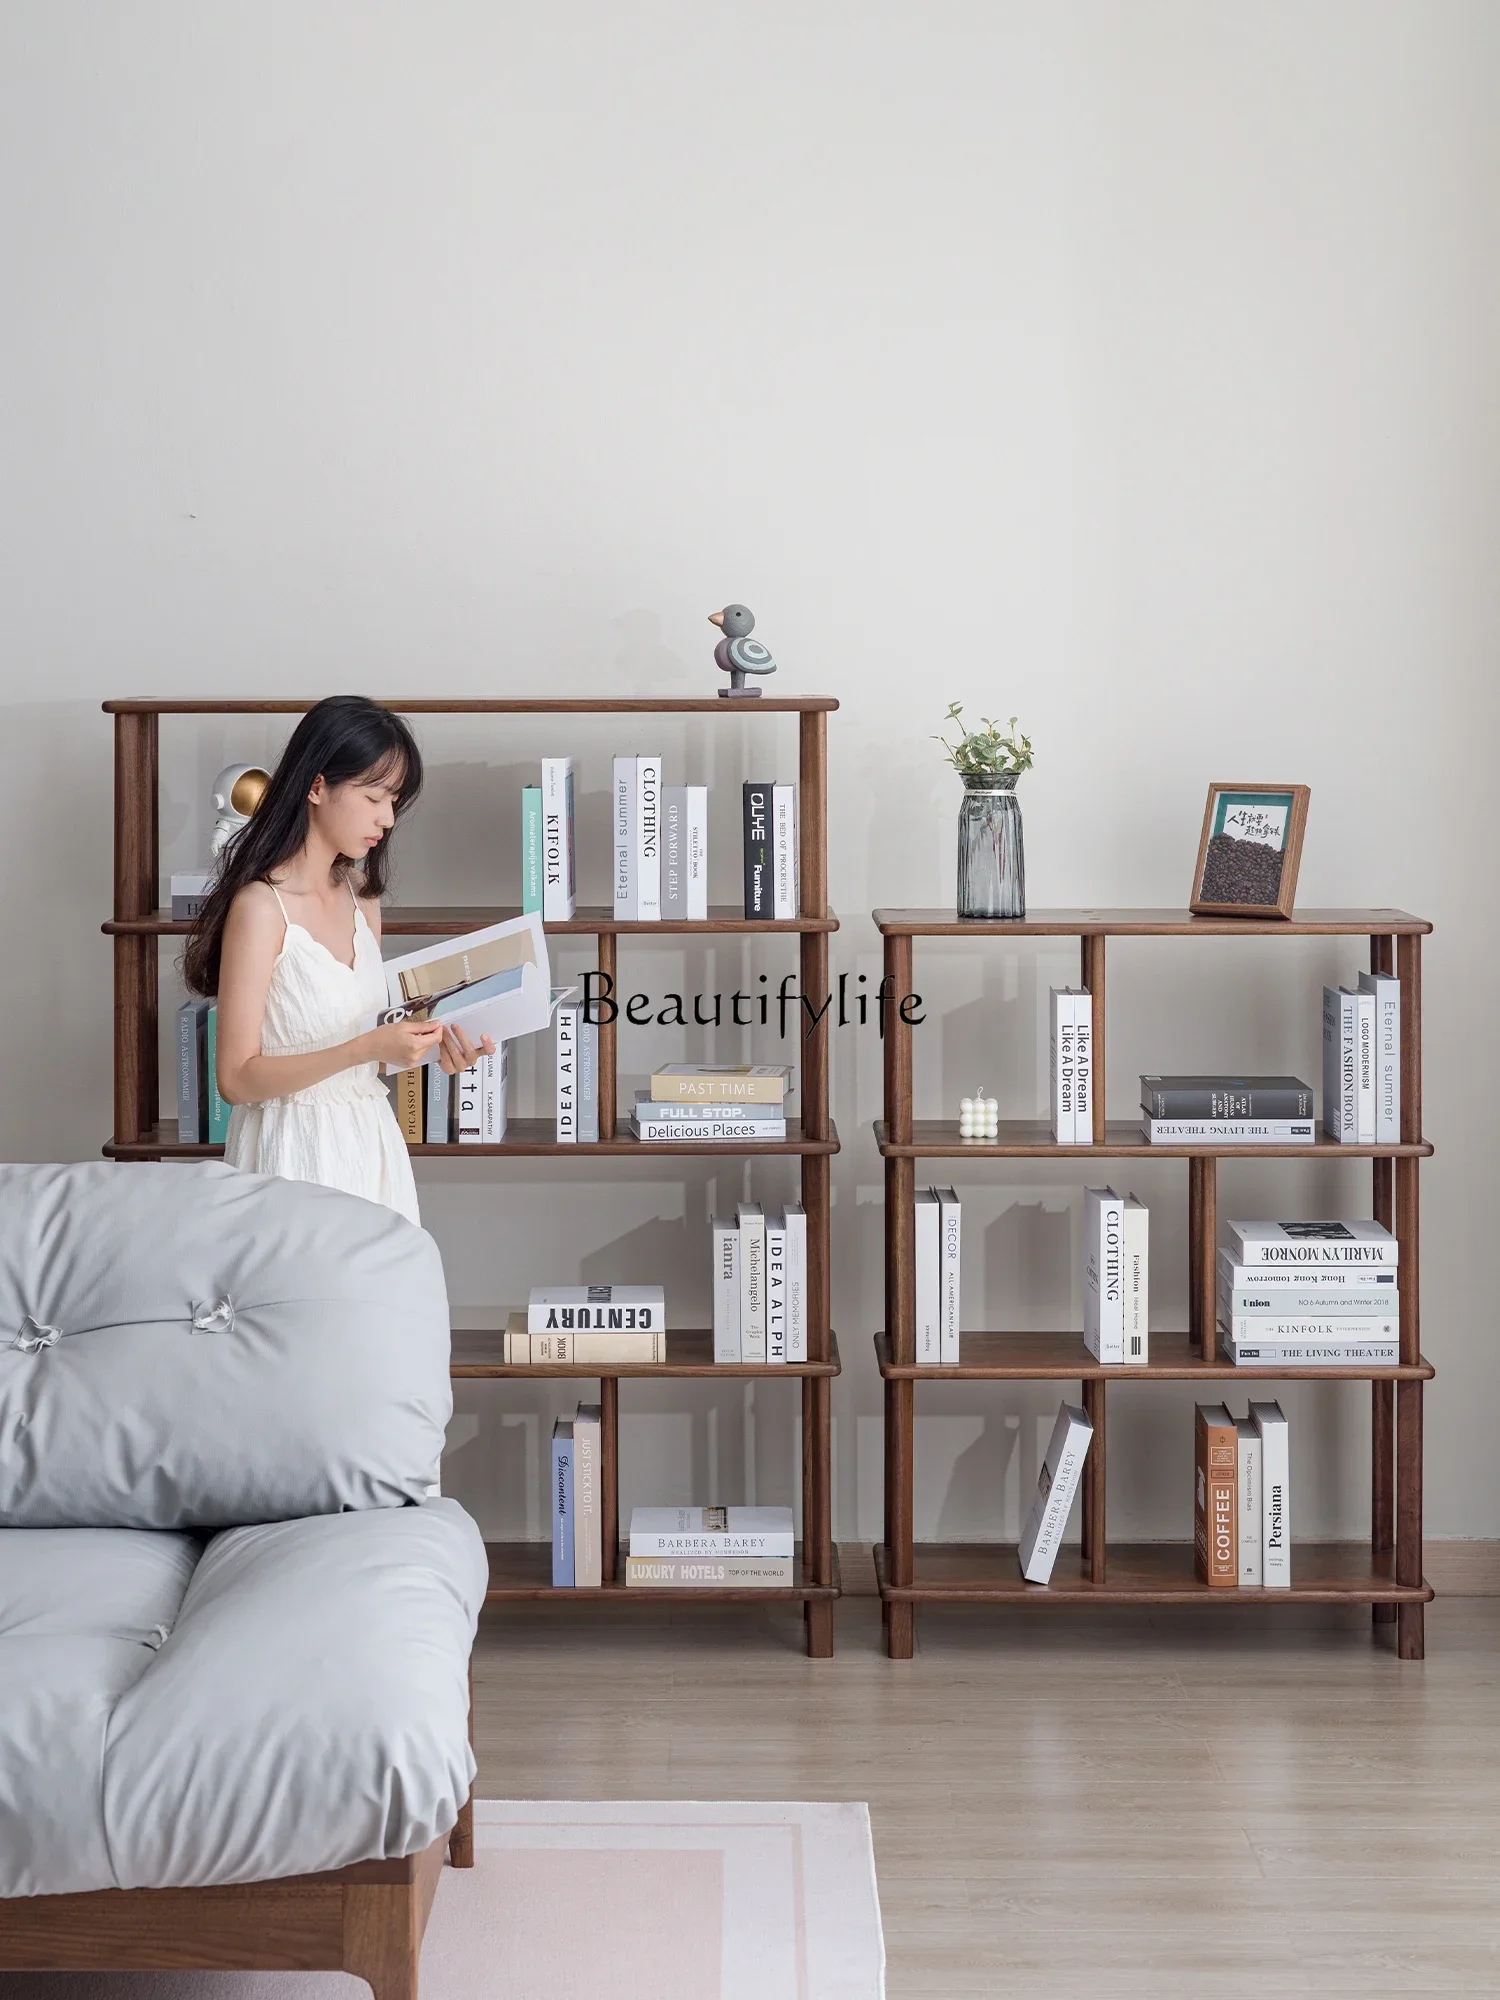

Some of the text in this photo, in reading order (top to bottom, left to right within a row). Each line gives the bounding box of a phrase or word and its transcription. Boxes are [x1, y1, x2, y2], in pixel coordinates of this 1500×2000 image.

[643, 767, 656, 858] CLOTHING
[546, 814, 560, 885] KIFOLK
[616, 778, 628, 900] Eternal summer
[669, 804, 678, 900] STEP FORWARD
[753, 864, 764, 912] Furniture
[1344, 1006, 1354, 1034] THE
[181, 1016, 190, 1102] RADIO ASTRONOMER
[1062, 1024, 1074, 1112] Like A Dream
[1077, 1024, 1089, 1112] Like A Dream
[1361, 1018, 1369, 1090] LOGO MODERNISM
[1384, 1001, 1396, 1122] Eternal summer
[560, 1016, 572, 1136] IDEA ALPH
[679, 1082, 755, 1096] PAST TIME
[648, 1124, 756, 1138] Delicious Places
[660, 1107, 746, 1118] FULL STOP.
[1156, 1126, 1206, 1135] THEATER
[1210, 1126, 1244, 1135] LIVING
[1248, 1126, 1270, 1135] THE
[1344, 1094, 1354, 1132] BOOK
[723, 1236, 737, 1280] ianra
[948, 1218, 956, 1259] DECOR
[1106, 1210, 1119, 1302] CLOTHING
[1262, 1248, 1384, 1260] MARILYN MONROE
[748, 1238, 760, 1312] Michelangelo
[771, 1238, 783, 1356] IDEA ALPH
[1243, 1299, 1270, 1307] Union
[546, 1308, 652, 1329] CENTURY
[557, 1338, 567, 1360] BOOK
[1282, 1349, 1302, 1357] THE
[1306, 1349, 1341, 1357] LIVING
[1344, 1349, 1394, 1357] THEATER
[582, 1438, 592, 1459] JUST
[557, 1455, 568, 1516] Discontent
[582, 1462, 592, 1488] STICK
[582, 1489, 592, 1503] TO
[582, 1505, 592, 1515] IT.
[1038, 1450, 1076, 1554] BARBERA BAREY
[1216, 1489, 1230, 1560] COFFEE
[1268, 1485, 1282, 1549] Persiana
[658, 1538, 766, 1548] BARBERA BAREY
[631, 1564, 676, 1579] LUXURY
[680, 1565, 724, 1580] HOTELS
